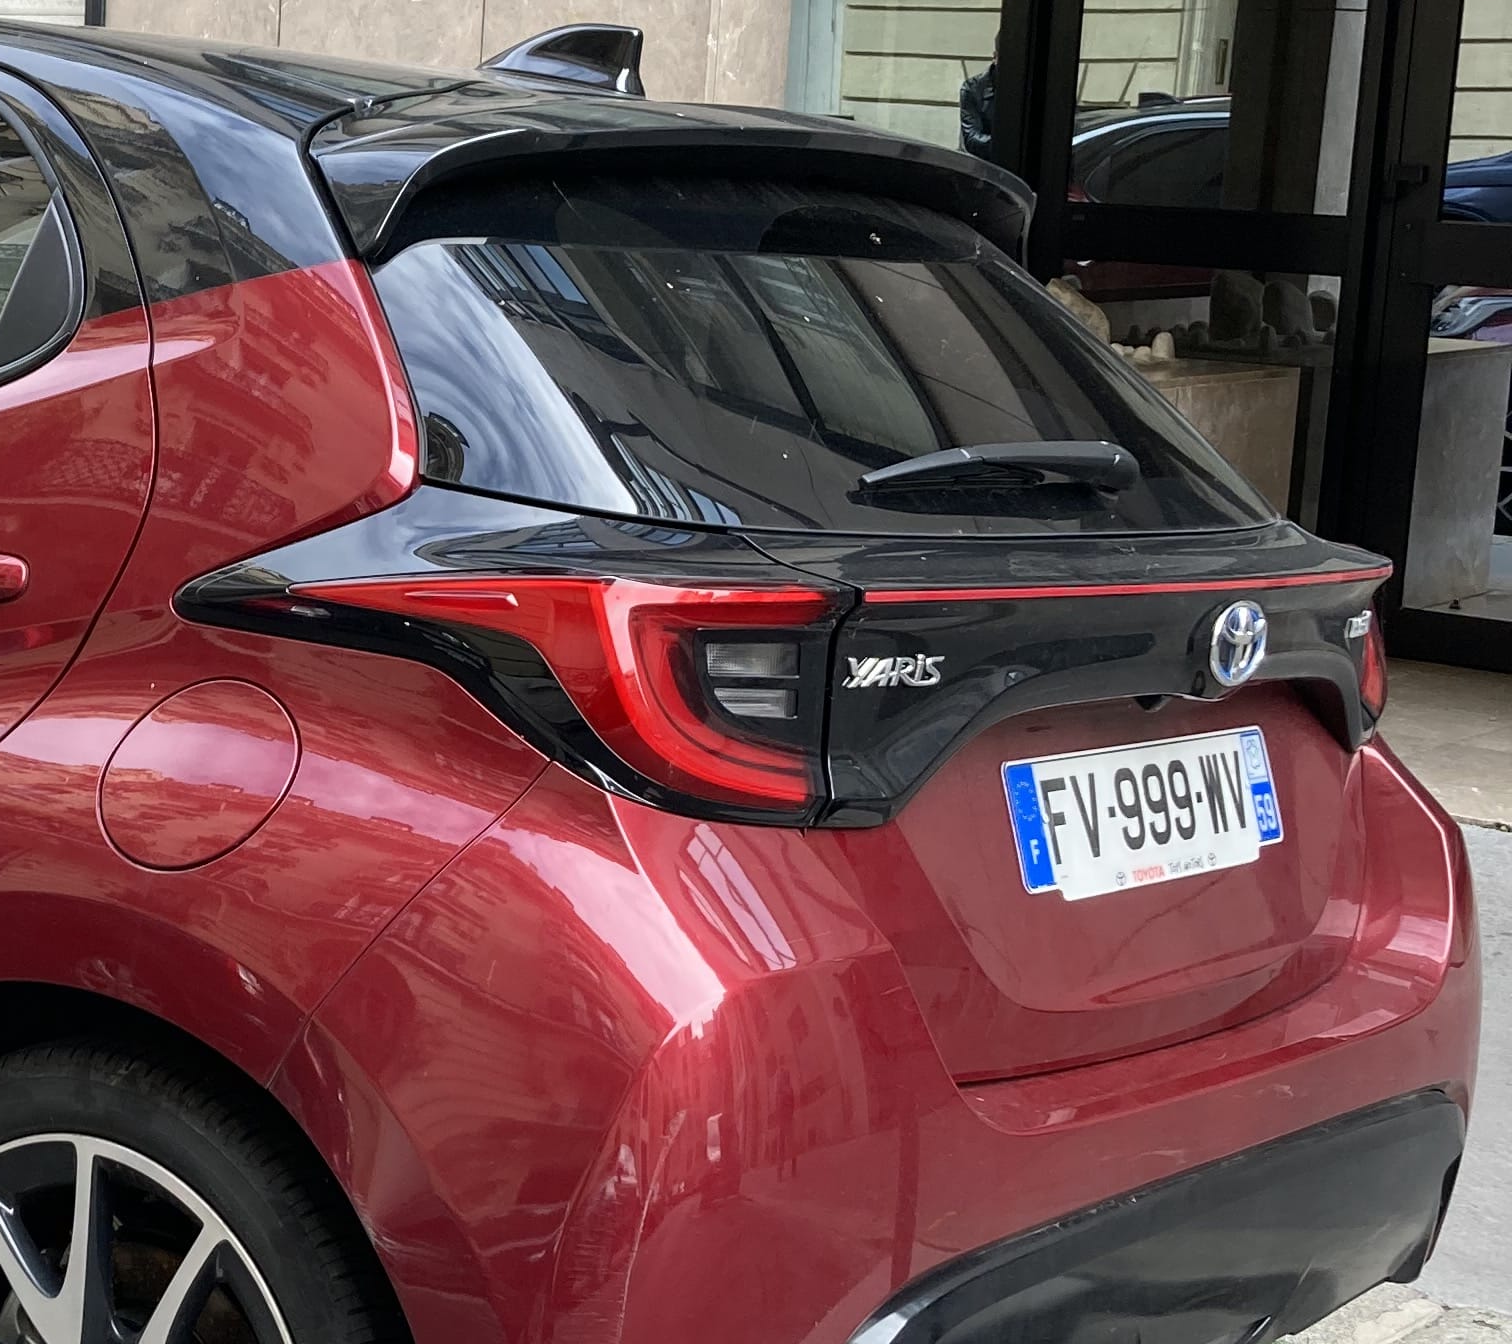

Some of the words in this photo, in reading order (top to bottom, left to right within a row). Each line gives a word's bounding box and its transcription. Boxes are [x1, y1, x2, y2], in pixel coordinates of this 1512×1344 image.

[1040, 750, 1247, 865] FV-999-WV
[1254, 793, 1277, 832] 59
[1029, 838, 1040, 865] F
